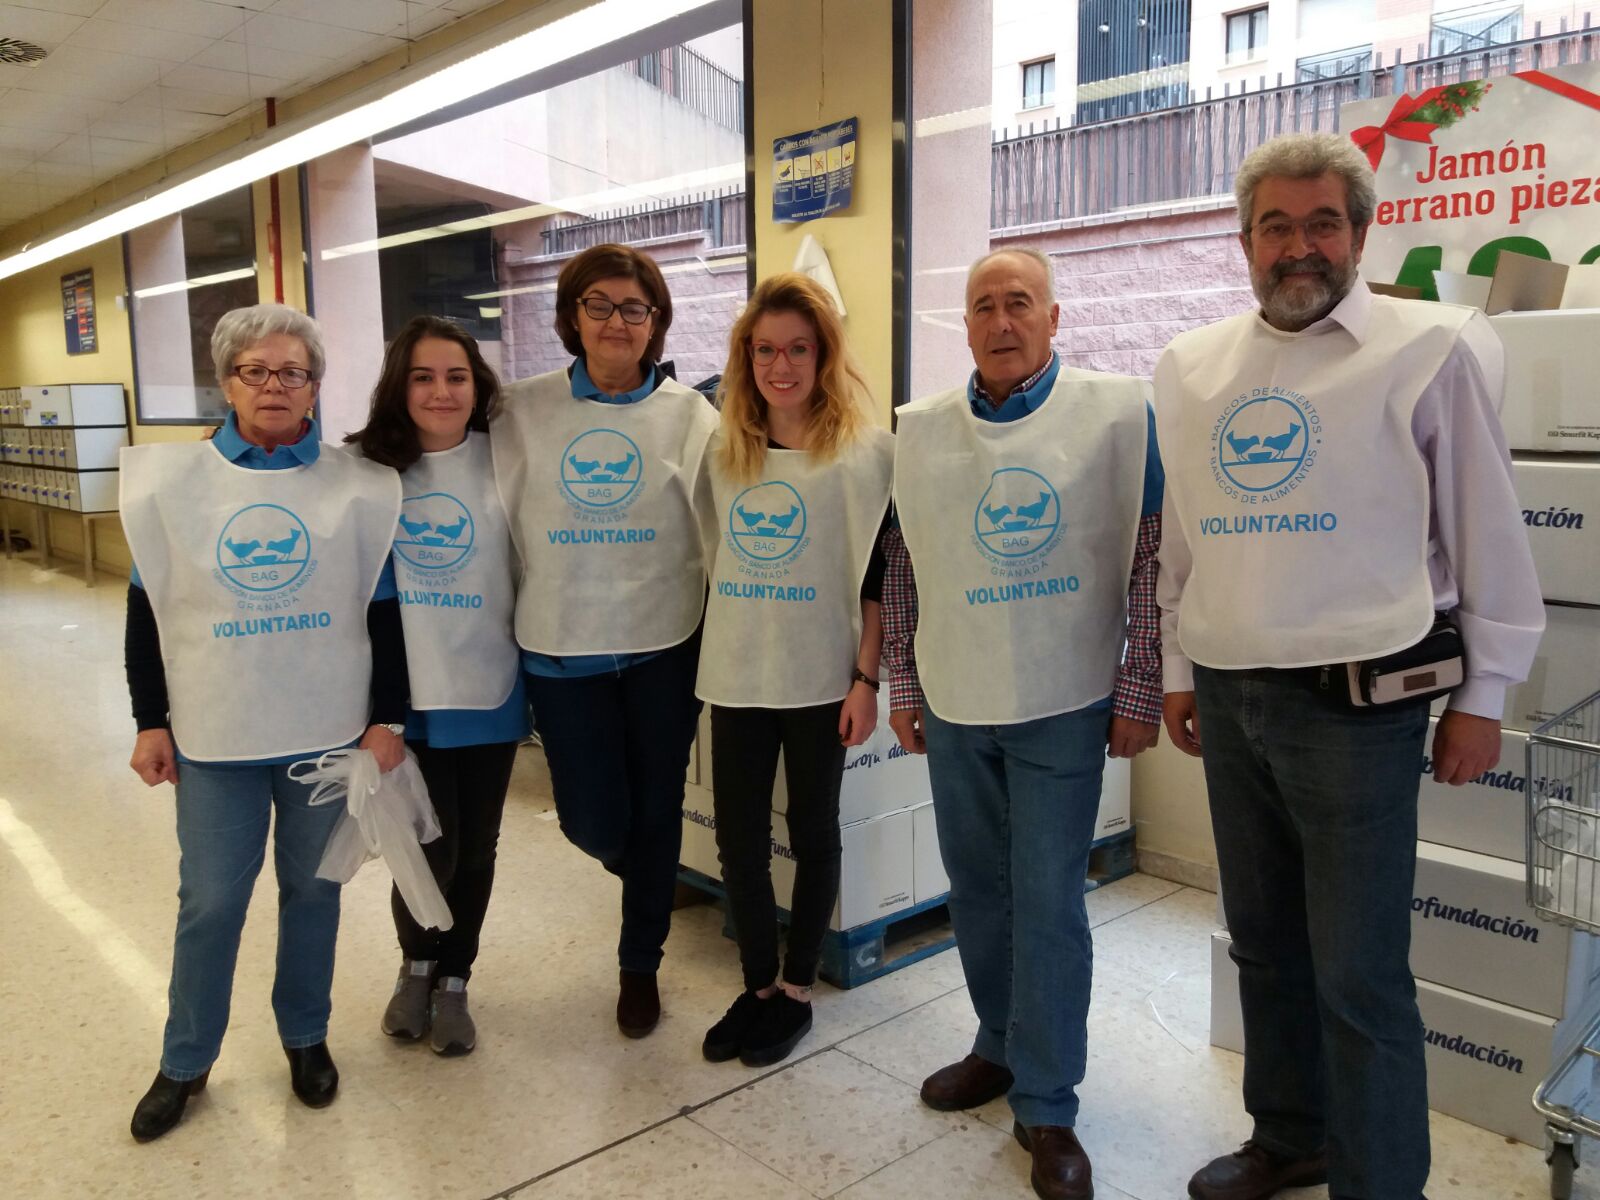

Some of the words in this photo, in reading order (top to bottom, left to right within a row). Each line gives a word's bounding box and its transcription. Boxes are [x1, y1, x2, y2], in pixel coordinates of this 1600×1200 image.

[1416, 140, 1546, 184] Jamón
[1368, 189, 1495, 226] errano
[1212, 393, 1248, 441] BANCOS
[1252, 387, 1270, 397] DE
[1271, 386, 1322, 434] ALIMENTOS
[1210, 456, 1238, 500] BANCOS
[1241, 494, 1257, 504] DE
[1262, 449, 1318, 504] ALIMENTOS
[587, 488, 612, 498] BAG
[574, 511, 628, 524] GRANADA
[1200, 512, 1337, 536] VOLUNTARIO
[547, 528, 656, 544] VOLUNTARIO
[1002, 536, 1030, 548] BAG
[753, 541, 776, 552] BAG
[418, 550, 444, 561] BAG
[251, 570, 280, 583] BAG
[738, 565, 790, 580] GRANADA
[991, 561, 1048, 578] GRANADA
[406, 574, 458, 587] GRANADA
[398, 590, 482, 608] OLUNTARIO
[718, 581, 816, 602] VOLUNTARIO
[965, 576, 1080, 606] VOLUNTARIO
[238, 596, 300, 612] GRANADA
[213, 611, 332, 638] VOLUNTARIO
[1411, 896, 1539, 944] ofundación
[1423, 1026, 1524, 1074] undación
